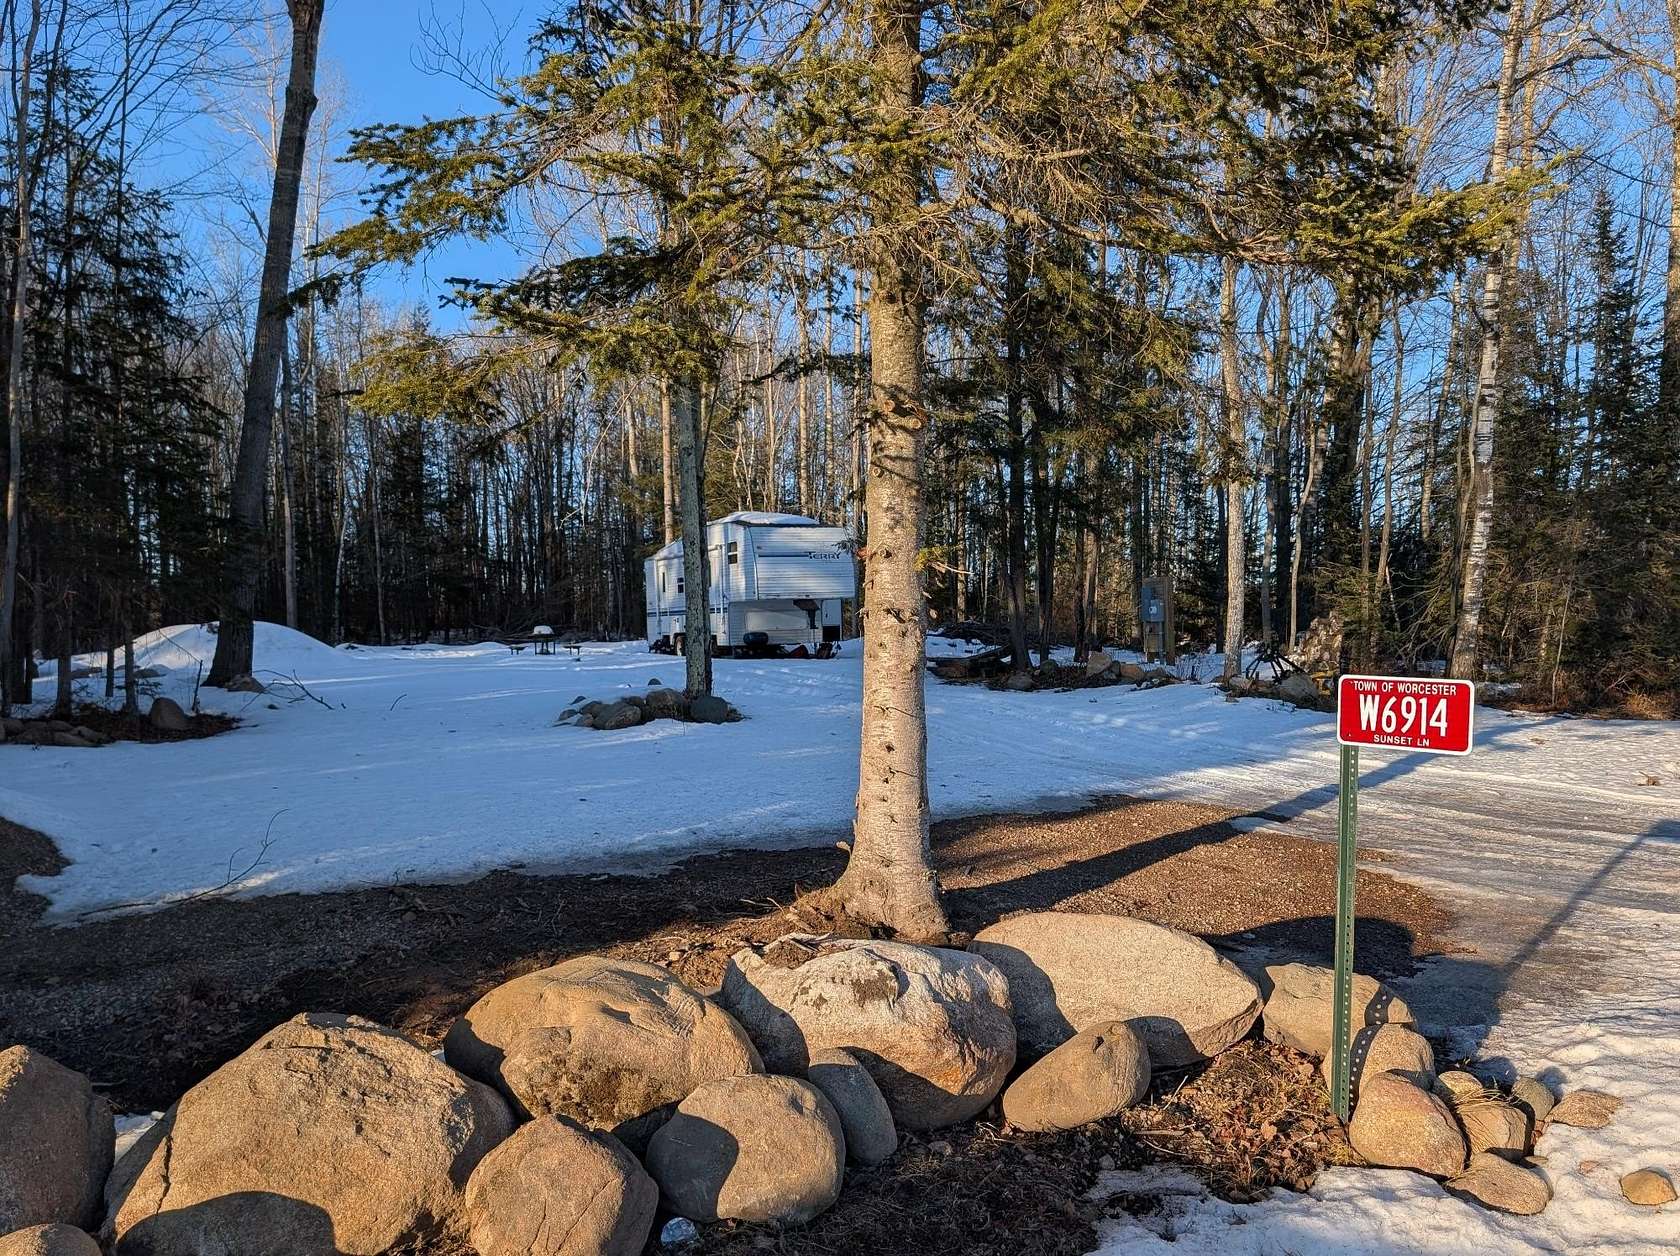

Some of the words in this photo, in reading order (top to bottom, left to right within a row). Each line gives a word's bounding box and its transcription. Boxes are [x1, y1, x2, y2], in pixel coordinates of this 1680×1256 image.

[1353, 681, 1377, 692] TOWN
[1381, 682, 1394, 692] OF
[1397, 683, 1457, 696] WORCESTER
[1359, 694, 1448, 737] W6914
[1373, 734, 1413, 745] SUNSET
[1417, 738, 1430, 747] LN
